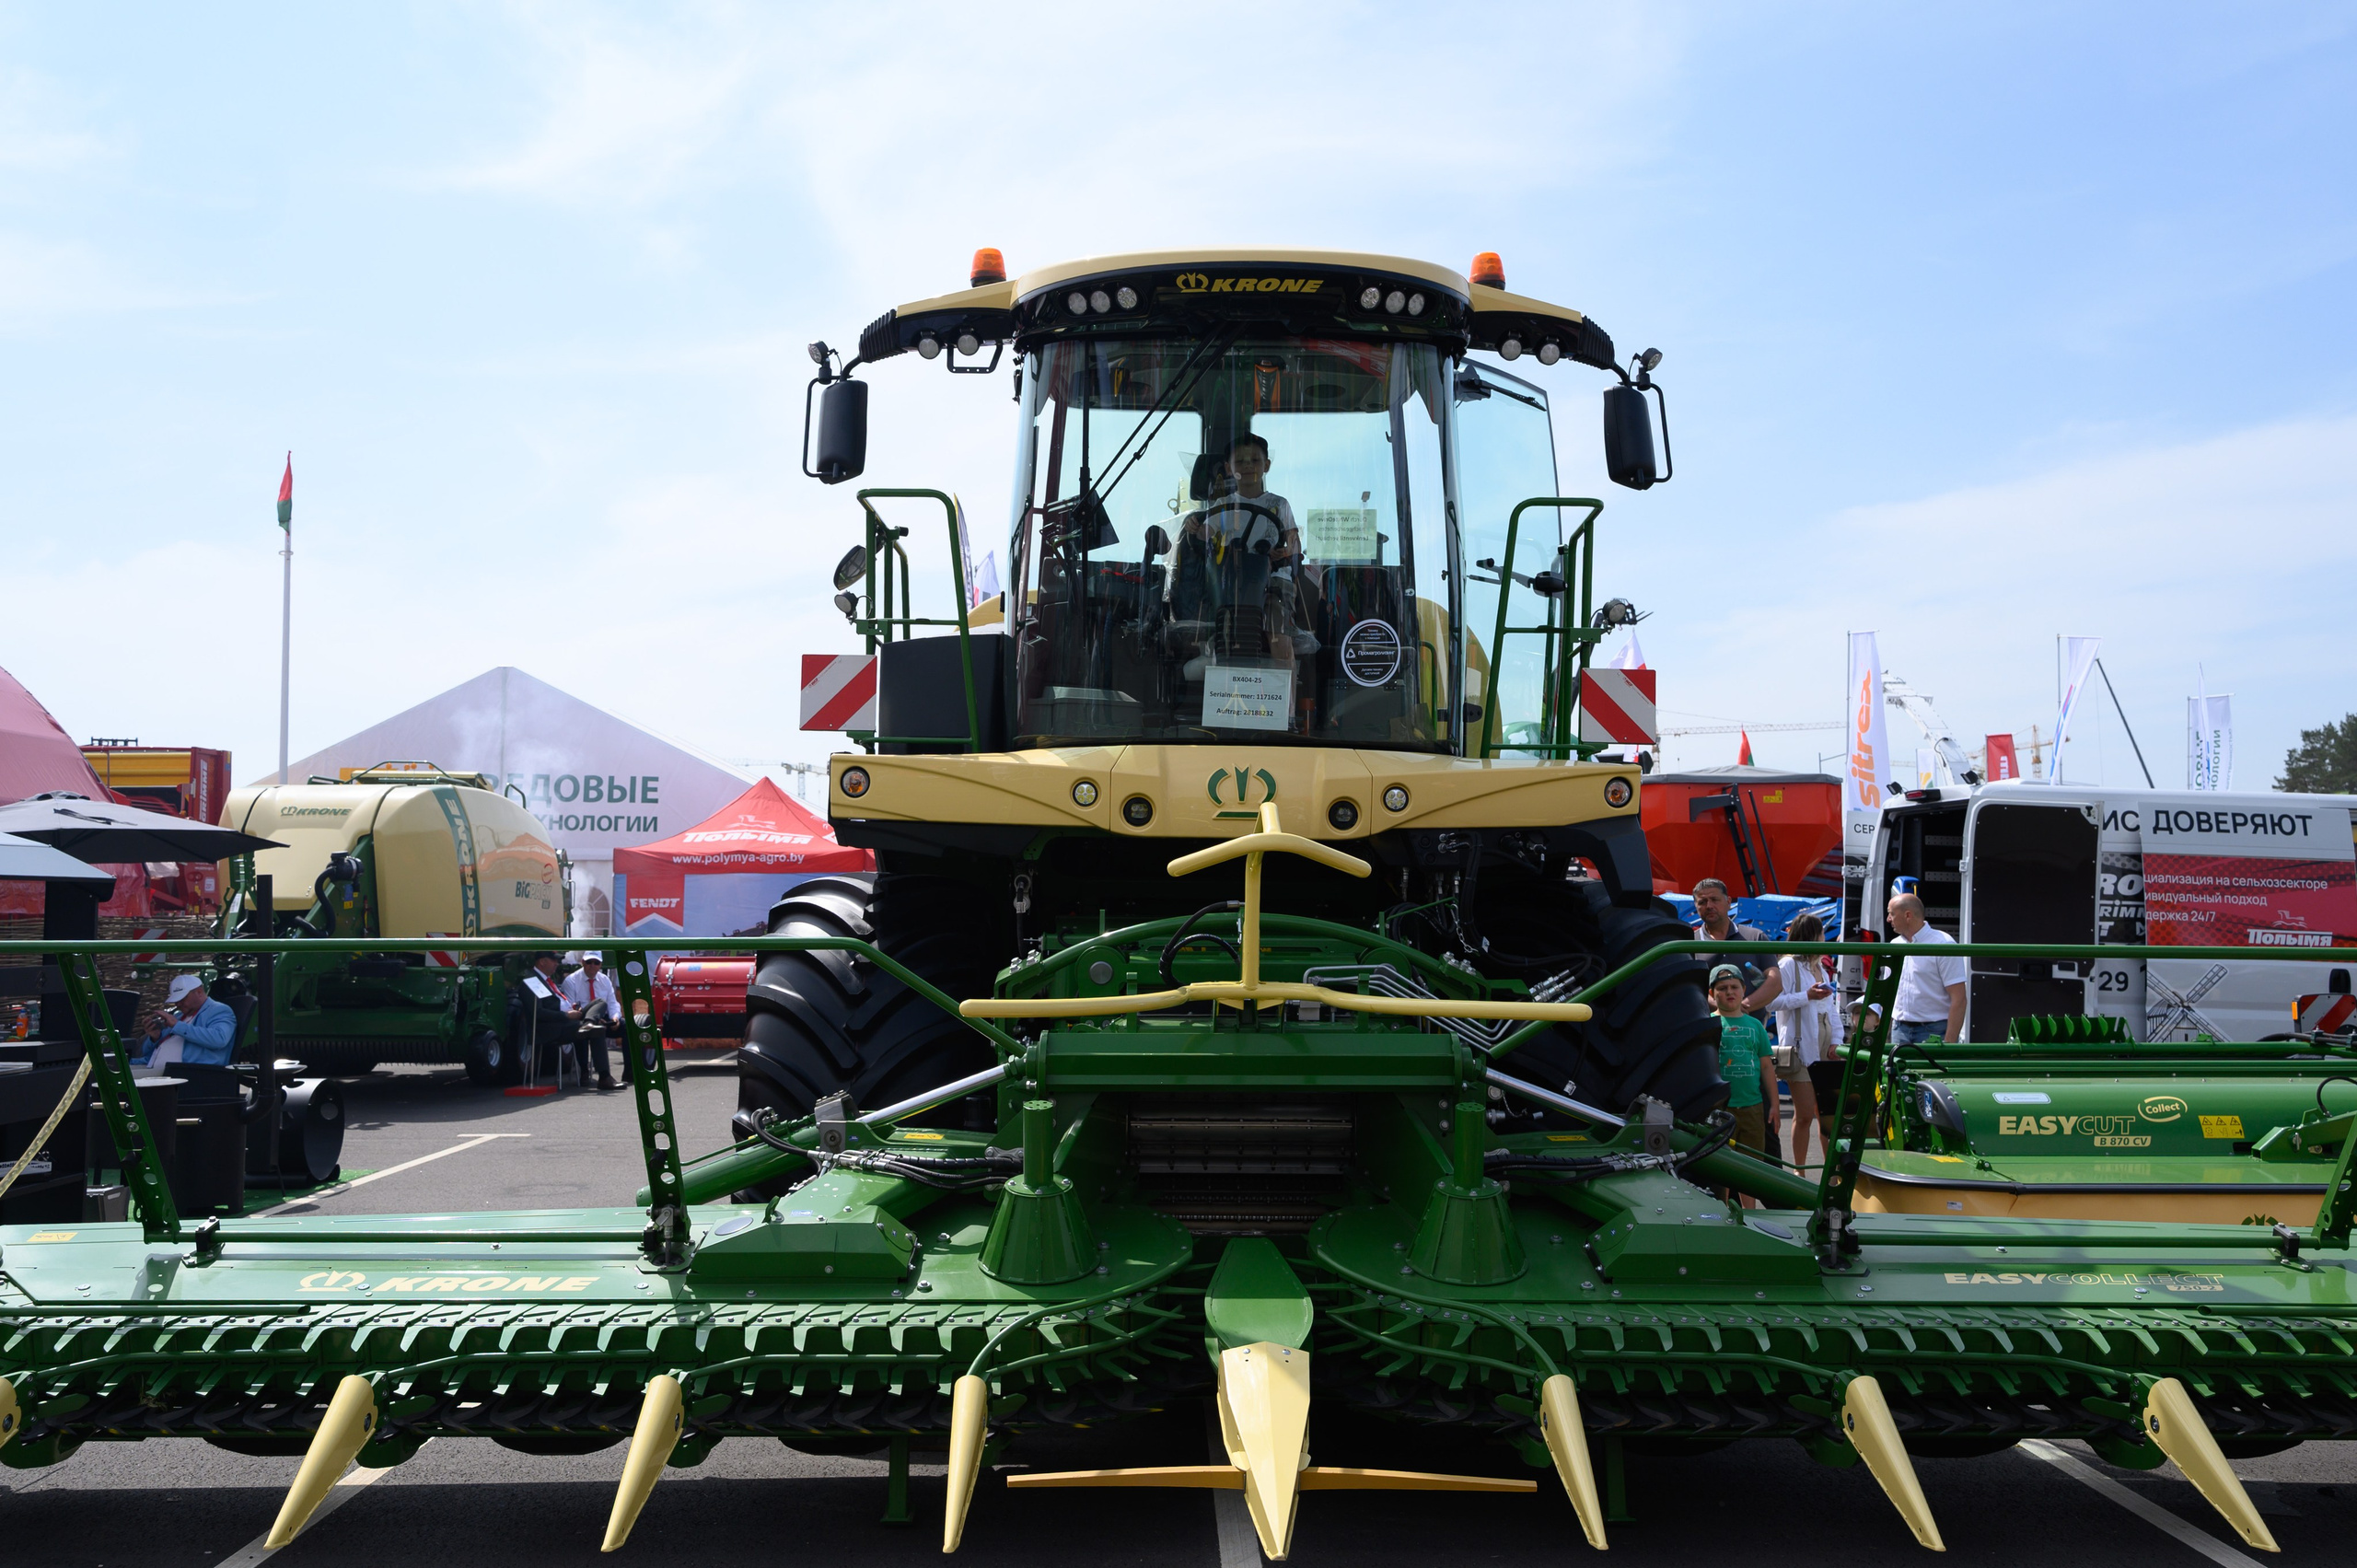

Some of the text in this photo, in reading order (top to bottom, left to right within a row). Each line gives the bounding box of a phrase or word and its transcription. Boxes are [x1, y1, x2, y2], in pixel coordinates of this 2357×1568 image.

[1211, 278, 1324, 293] KRONE
[1209, 691, 1255, 700] Serialnummer:
[1216, 707, 1242, 716] Auftrag:
[1851, 668, 1880, 808] sitrex
[296, 807, 353, 816] KRONE
[2153, 809, 2312, 837] ДОВЕРЯЮТ
[446, 798, 476, 909] KRONE
[672, 853, 806, 865] www.polymya-agro.by
[2215, 877, 2230, 887] на
[2232, 877, 2328, 891] сельхозсекторе
[630, 898, 680, 908] FENDT
[2223, 896, 2268, 907] подход
[2190, 911, 2216, 923] 24/7
[2247, 928, 2333, 948] Полымя
[2098, 970, 2129, 993] 29
[2145, 1102, 2180, 1114] Collect
[1999, 1116, 2136, 1135] EASYCUT
[2099, 1137, 2148, 1145] B 870 CV
[372, 1276, 601, 1292] KRONE
[1944, 1272, 2224, 1285] EASYCOLLECT
